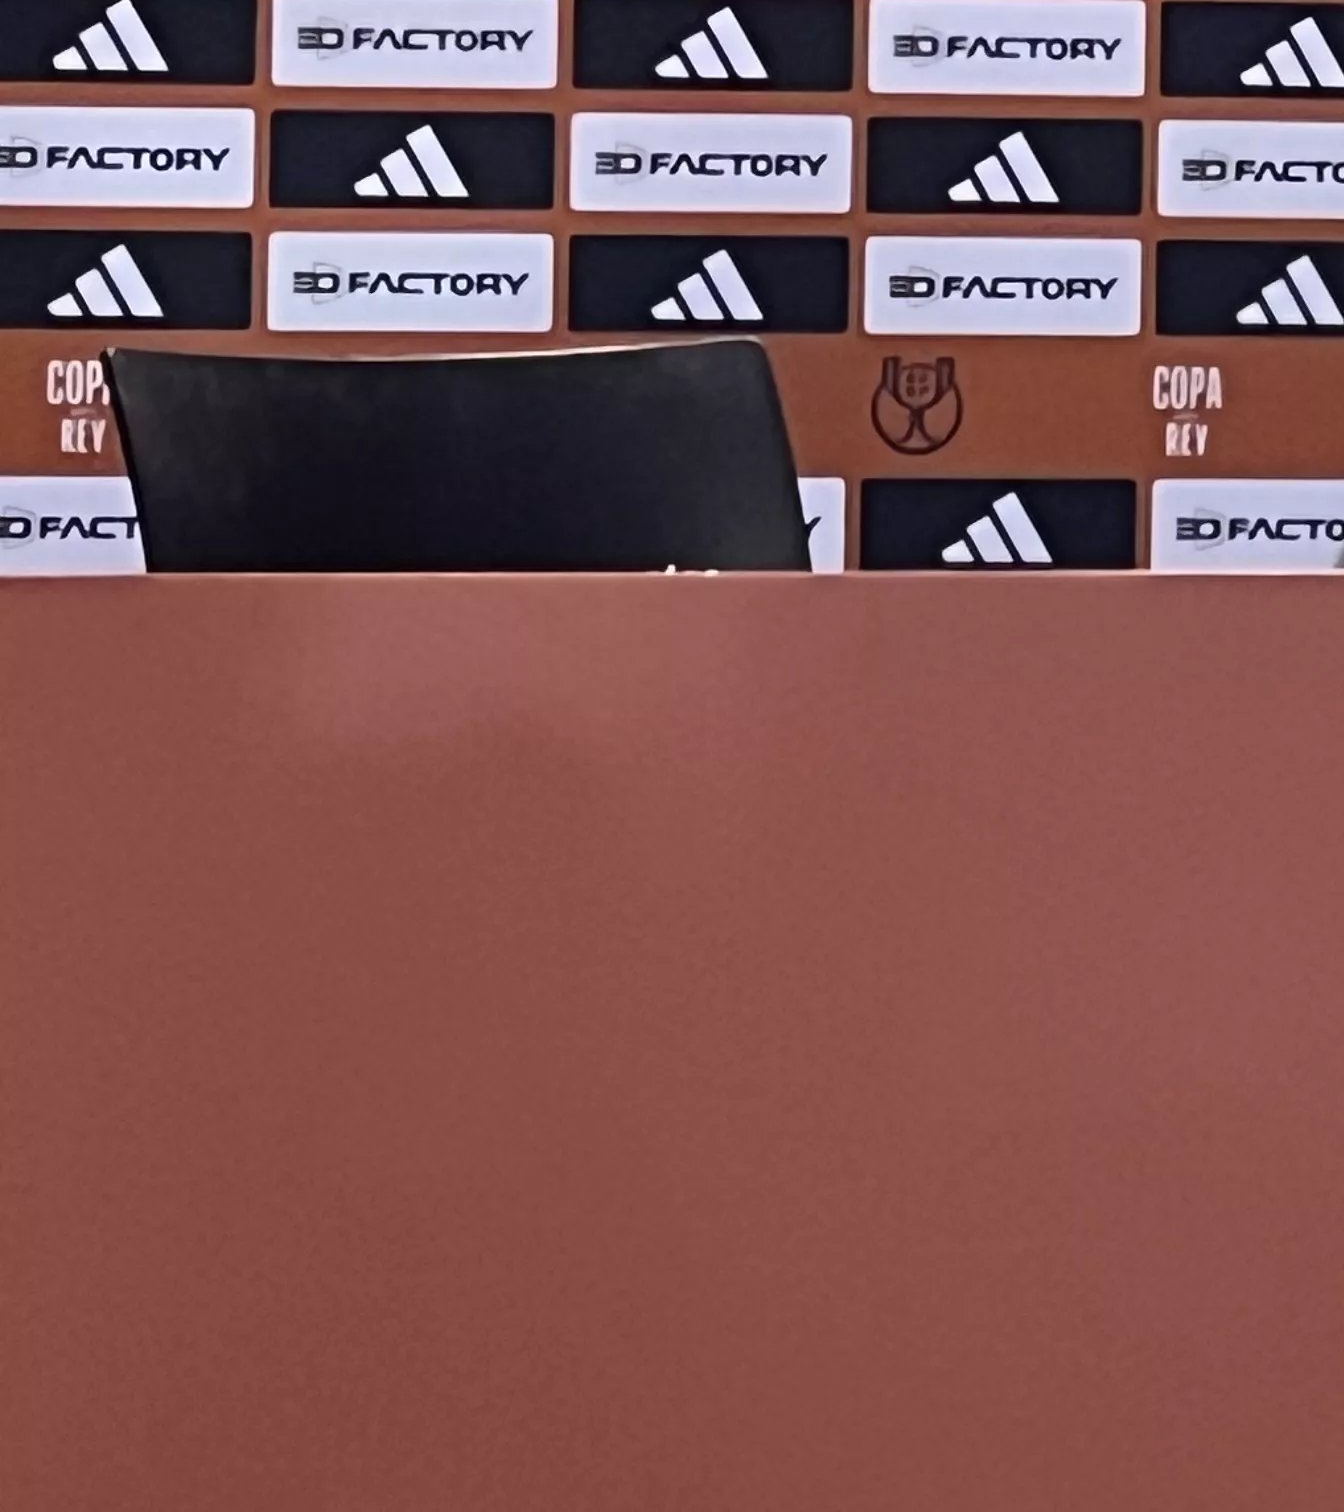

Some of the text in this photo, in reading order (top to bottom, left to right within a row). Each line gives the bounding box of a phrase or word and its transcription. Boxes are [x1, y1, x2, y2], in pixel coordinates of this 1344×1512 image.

[353, 28, 533, 52] FACTORY
[946, 36, 1121, 60] FACTORY
[46, 146, 230, 171] FACTORY
[650, 153, 827, 177] FACTORY
[349, 272, 529, 296] FACTORY
[942, 276, 1118, 300] FACTORY
[1153, 366, 1221, 409] COPA
[39, 517, 139, 539] FACT
